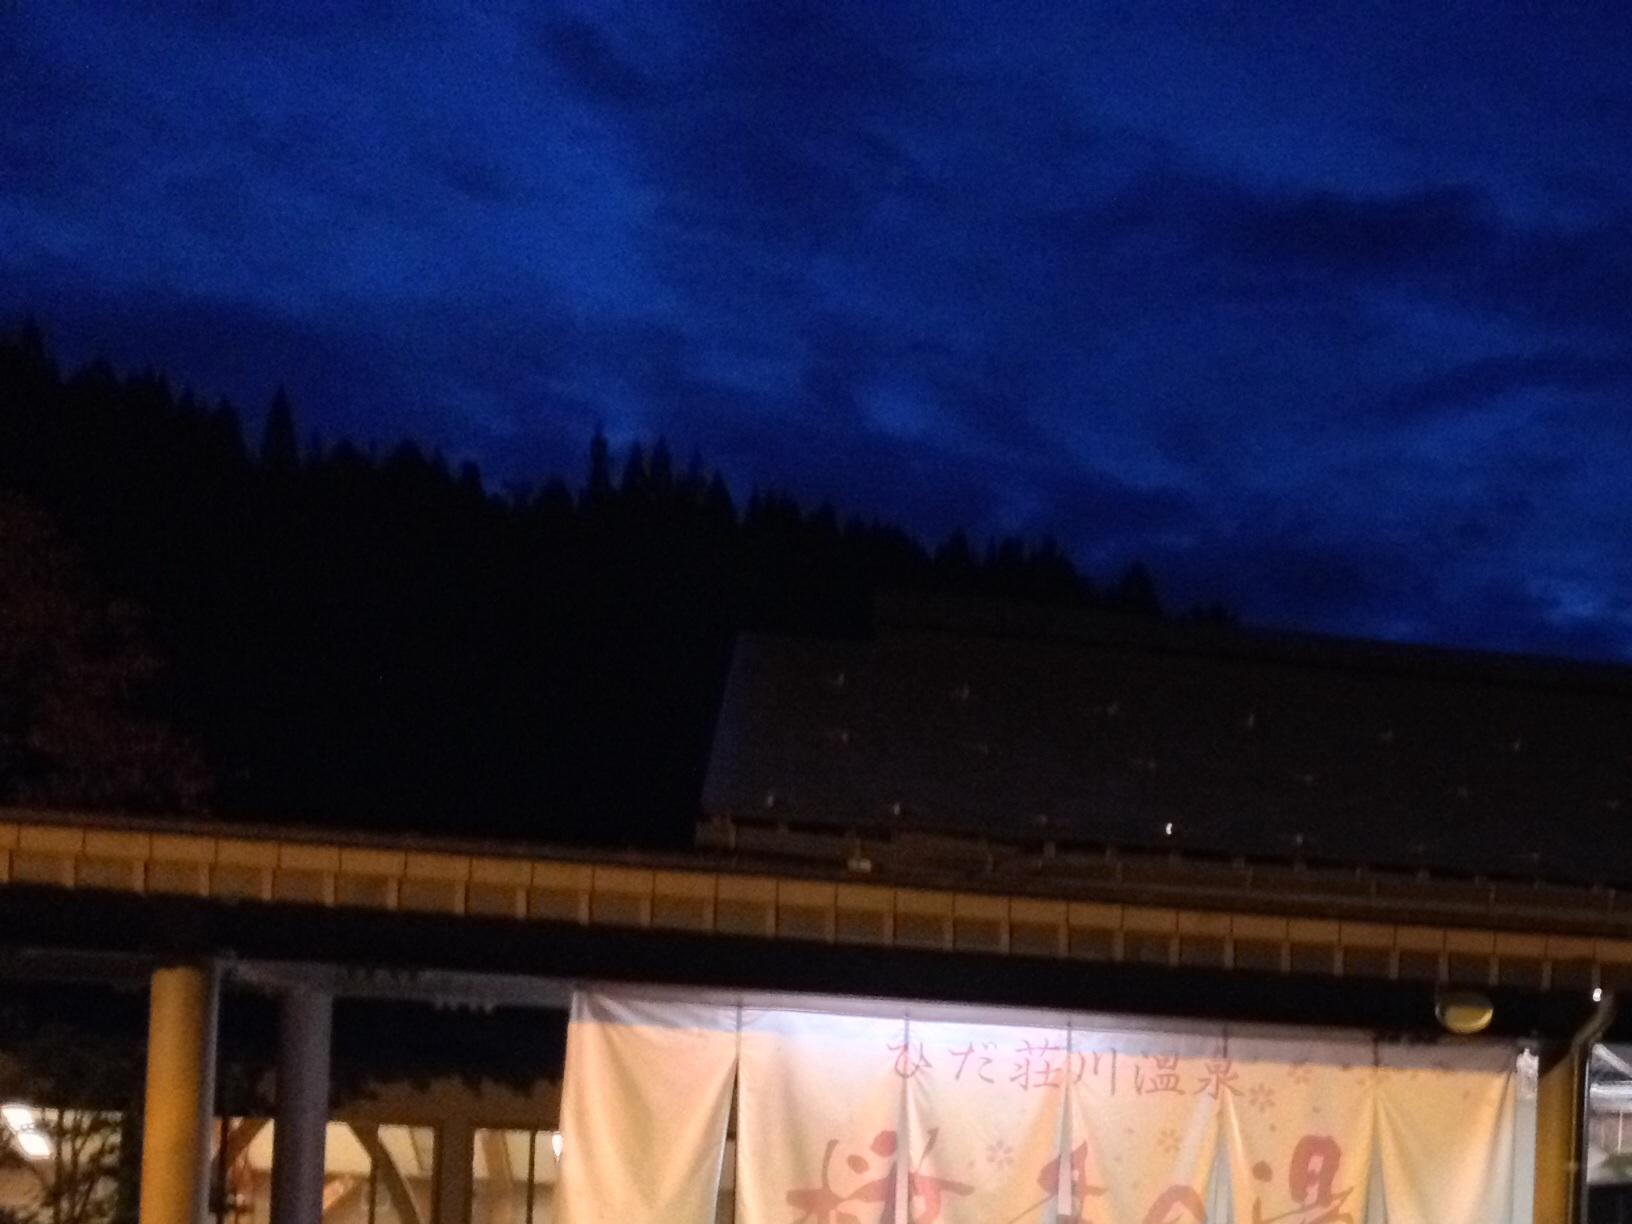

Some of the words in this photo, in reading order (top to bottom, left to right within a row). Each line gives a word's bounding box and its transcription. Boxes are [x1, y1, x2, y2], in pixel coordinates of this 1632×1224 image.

[887, 1040, 1245, 1099] ひだ荘川温泉
